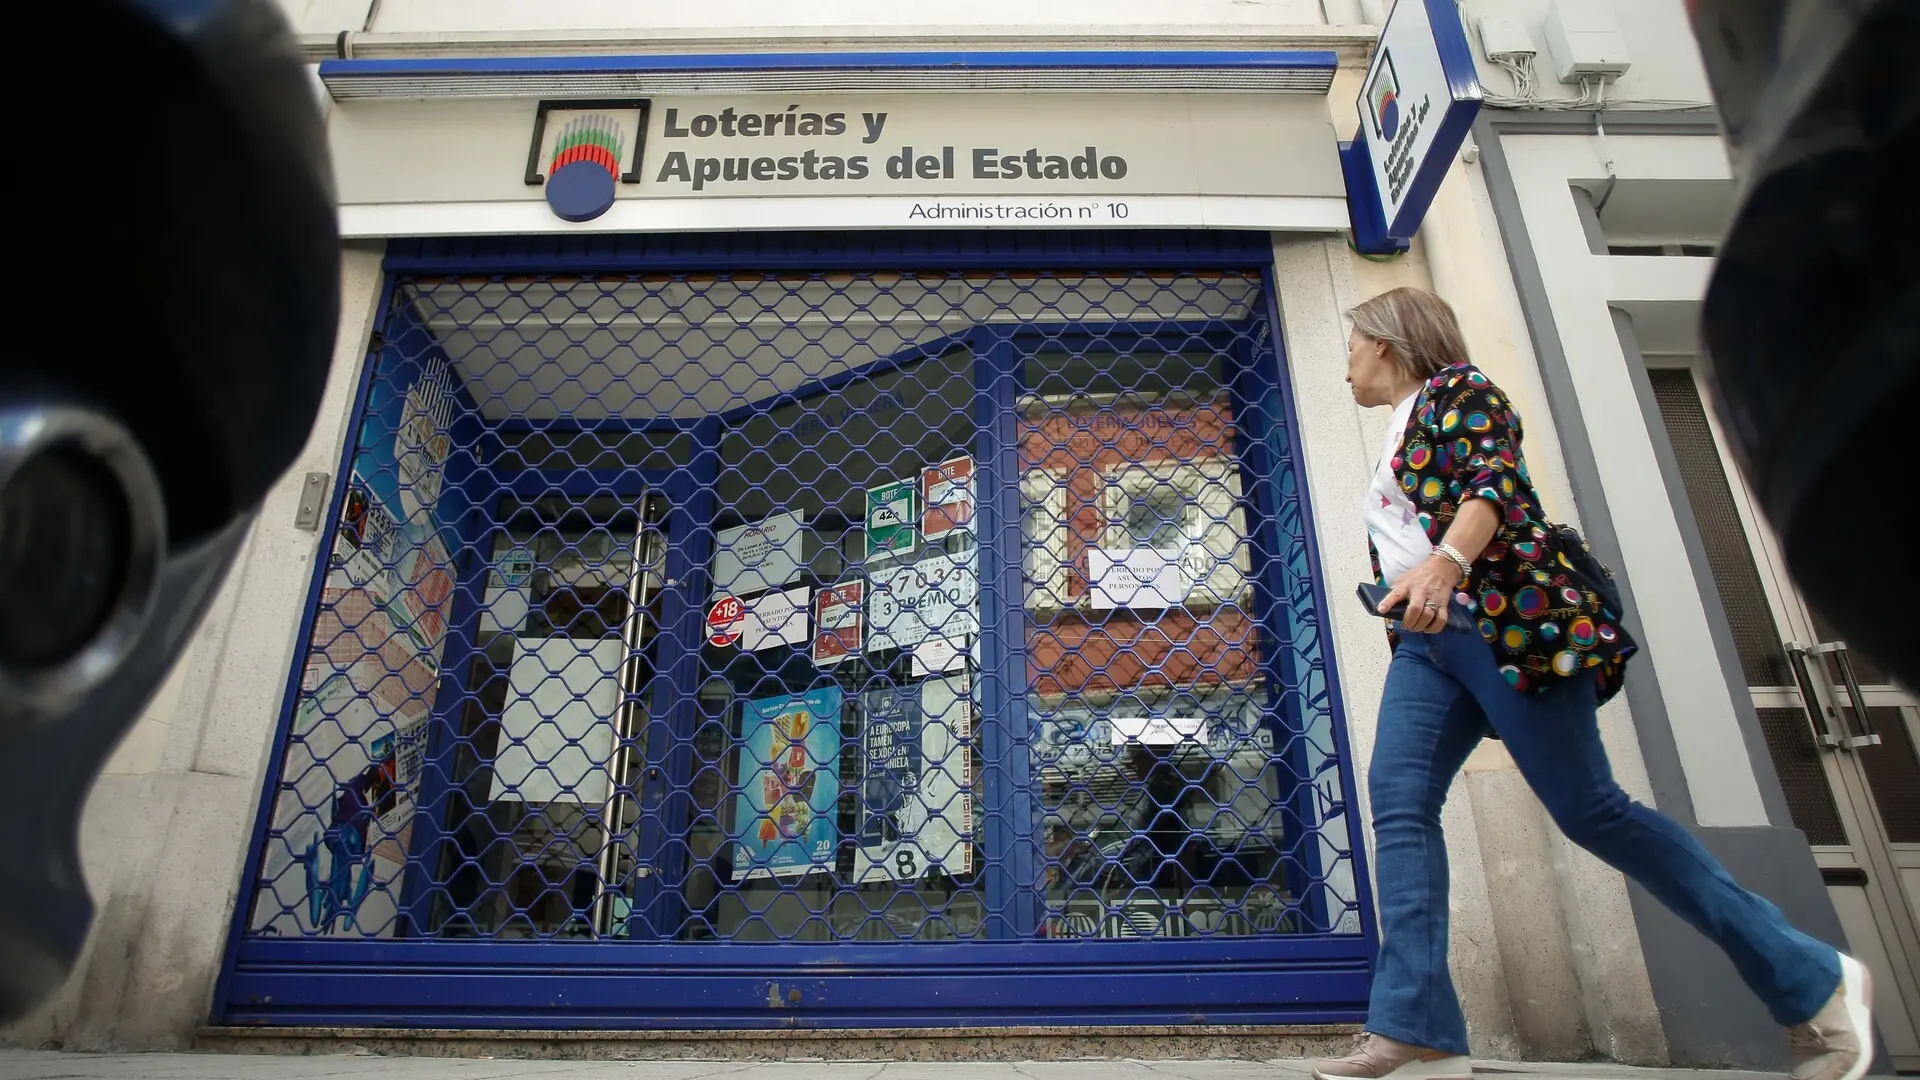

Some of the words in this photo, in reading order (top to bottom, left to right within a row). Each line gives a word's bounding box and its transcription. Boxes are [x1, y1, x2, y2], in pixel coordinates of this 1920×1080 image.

[663, 104, 847, 138] Loterías
[861, 112, 888, 144] y
[1383, 114, 1411, 174] Loterías
[1410, 102, 1417, 120] y
[1388, 122, 1419, 189] Apuestas
[1418, 93, 1431, 124] del
[656, 149, 869, 191] Apuestas
[885, 146, 954, 180] del
[972, 146, 1128, 180] Estado
[1390, 156, 1415, 205] Estado
[909, 202, 1073, 219] Administración
[1108, 203, 1129, 219] 10
[938, 465, 956, 480] BOTE
[881, 488, 898, 501] BOTE
[830, 589, 847, 602] BOTE
[715, 601, 738, 618] +18
[755, 609, 783, 619] ERRADO
[870, 726, 875, 736] A
[869, 748, 878, 760] SE
[877, 756, 909, 770] INIELA
[816, 839, 830, 852] 20
[895, 849, 917, 879] 8
